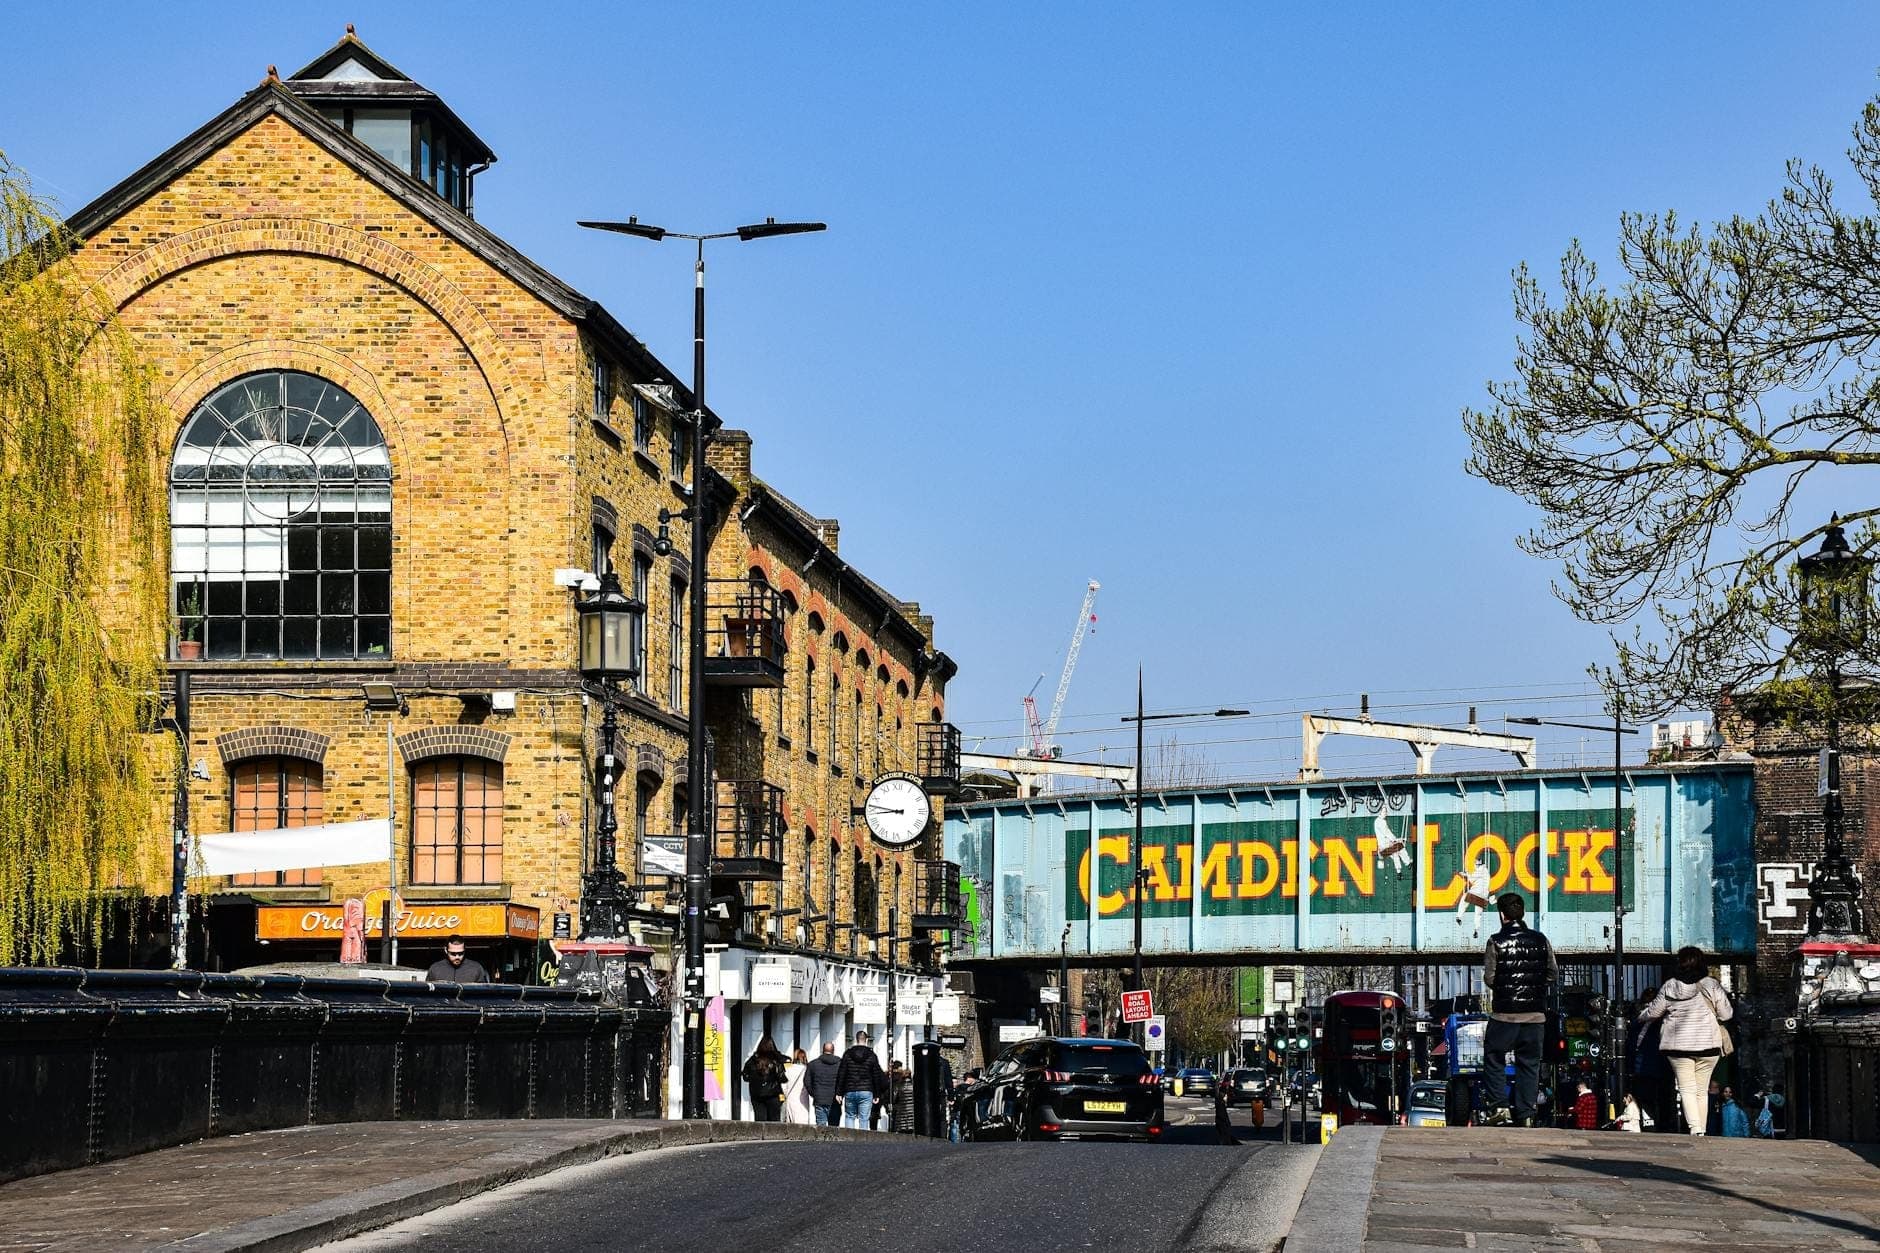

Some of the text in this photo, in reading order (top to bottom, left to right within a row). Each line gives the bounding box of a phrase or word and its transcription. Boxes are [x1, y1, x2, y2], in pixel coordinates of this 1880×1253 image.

[904, 773, 923, 785] LOCK
[663, 842, 683, 850] CCTV
[1078, 836, 1379, 915] CAMDEN
[1411, 821, 1617, 910] LOCK
[301, 911, 462, 933] Orage Juice
[1126, 1005, 1150, 1013] LAYOUT
[704, 1023, 719, 1072] Happy Socks
